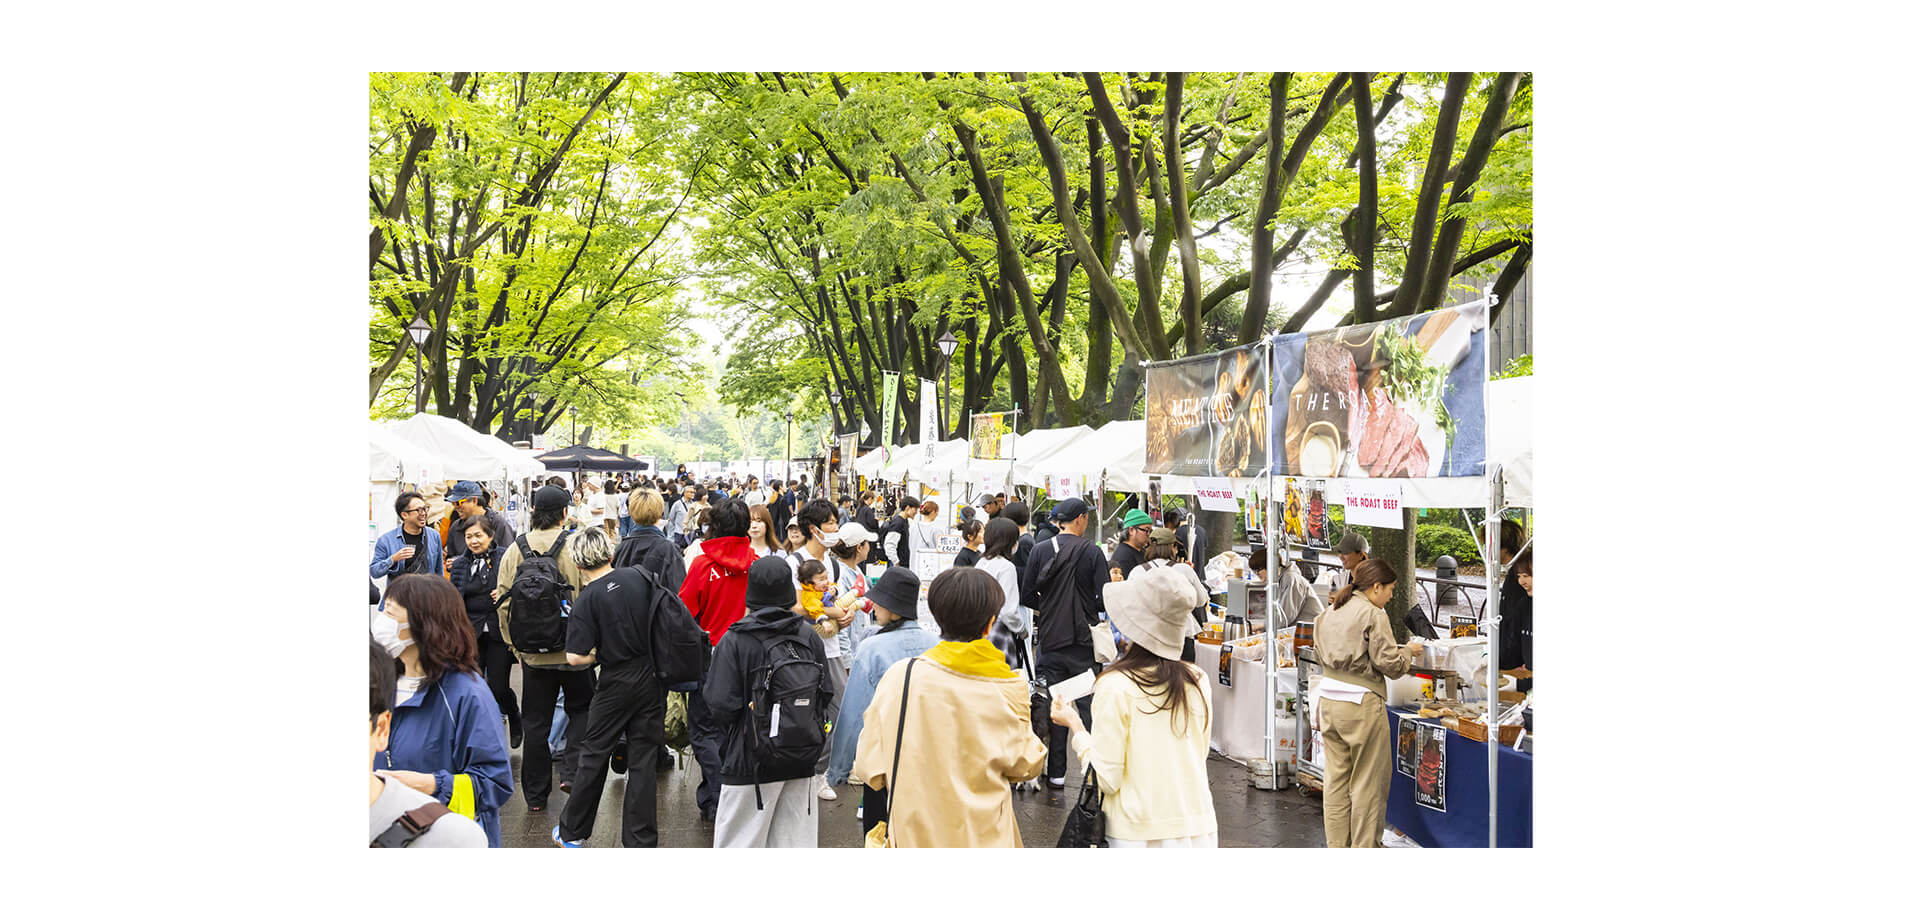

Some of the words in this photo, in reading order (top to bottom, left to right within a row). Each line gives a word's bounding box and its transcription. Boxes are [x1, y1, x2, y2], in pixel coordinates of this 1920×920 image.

[1295, 393, 1330, 412] THE
[1338, 385, 1395, 410] ROAST
[1196, 489, 1207, 498] THE
[1207, 490, 1222, 498] ROAST
[1222, 490, 1233, 499] BEEF
[1346, 496, 1359, 508] THE
[1360, 497, 1381, 509] ROAST
[1383, 498, 1398, 510] BEEF
